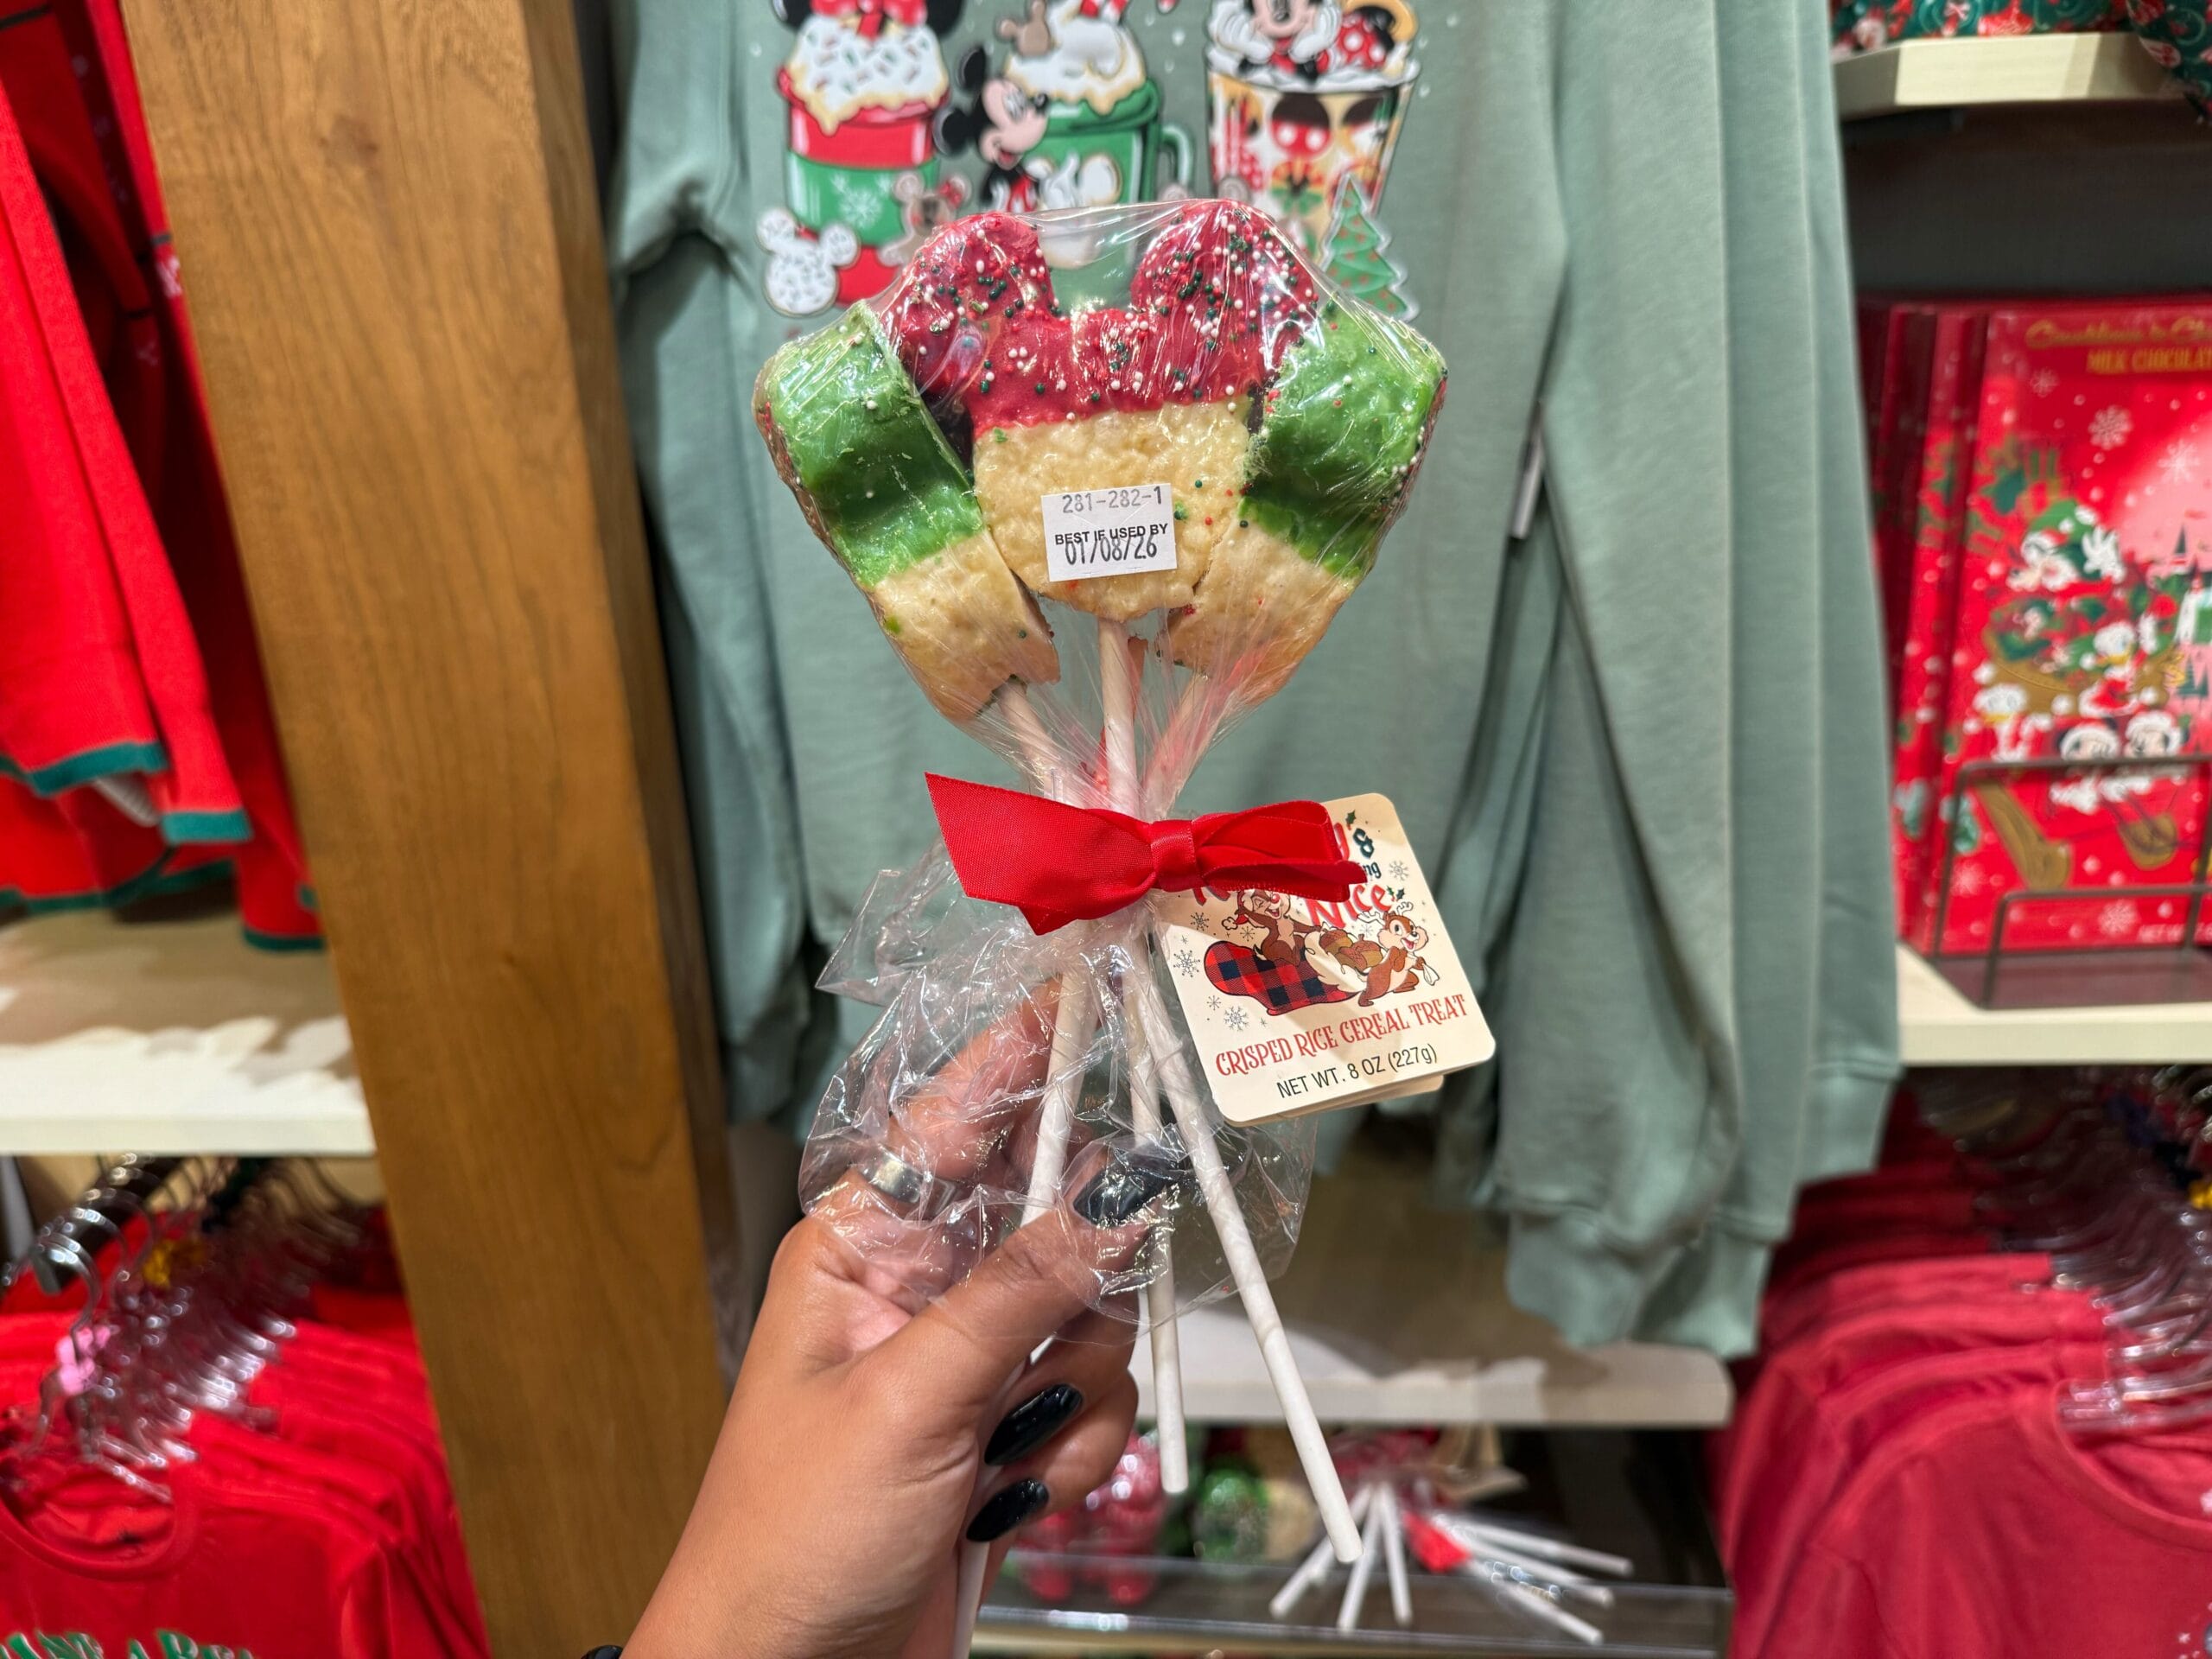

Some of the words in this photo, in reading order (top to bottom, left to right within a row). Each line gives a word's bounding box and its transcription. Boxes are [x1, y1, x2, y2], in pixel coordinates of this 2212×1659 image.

[1062, 486, 1162, 513] 281-282-1
[1055, 531, 1090, 545] BEST
[1094, 530, 1105, 542] IF
[1109, 526, 1146, 540] USED
[1150, 524, 1168, 537] BY
[1065, 534, 1157, 565] 01/08/26
[1215, 1037, 1294, 1076] CRISPED
[1294, 1026, 1338, 1058] RICE
[1339, 1009, 1410, 1044] CEREAL
[1408, 994, 1468, 1027] TREAT
[1276, 1076, 1310, 1098] NET
[1311, 1067, 1346, 1090] WT.
[1350, 1064, 1360, 1079] 8
[1361, 1056, 1386, 1076] OZ
[1388, 1043, 1437, 1073] (227g)
